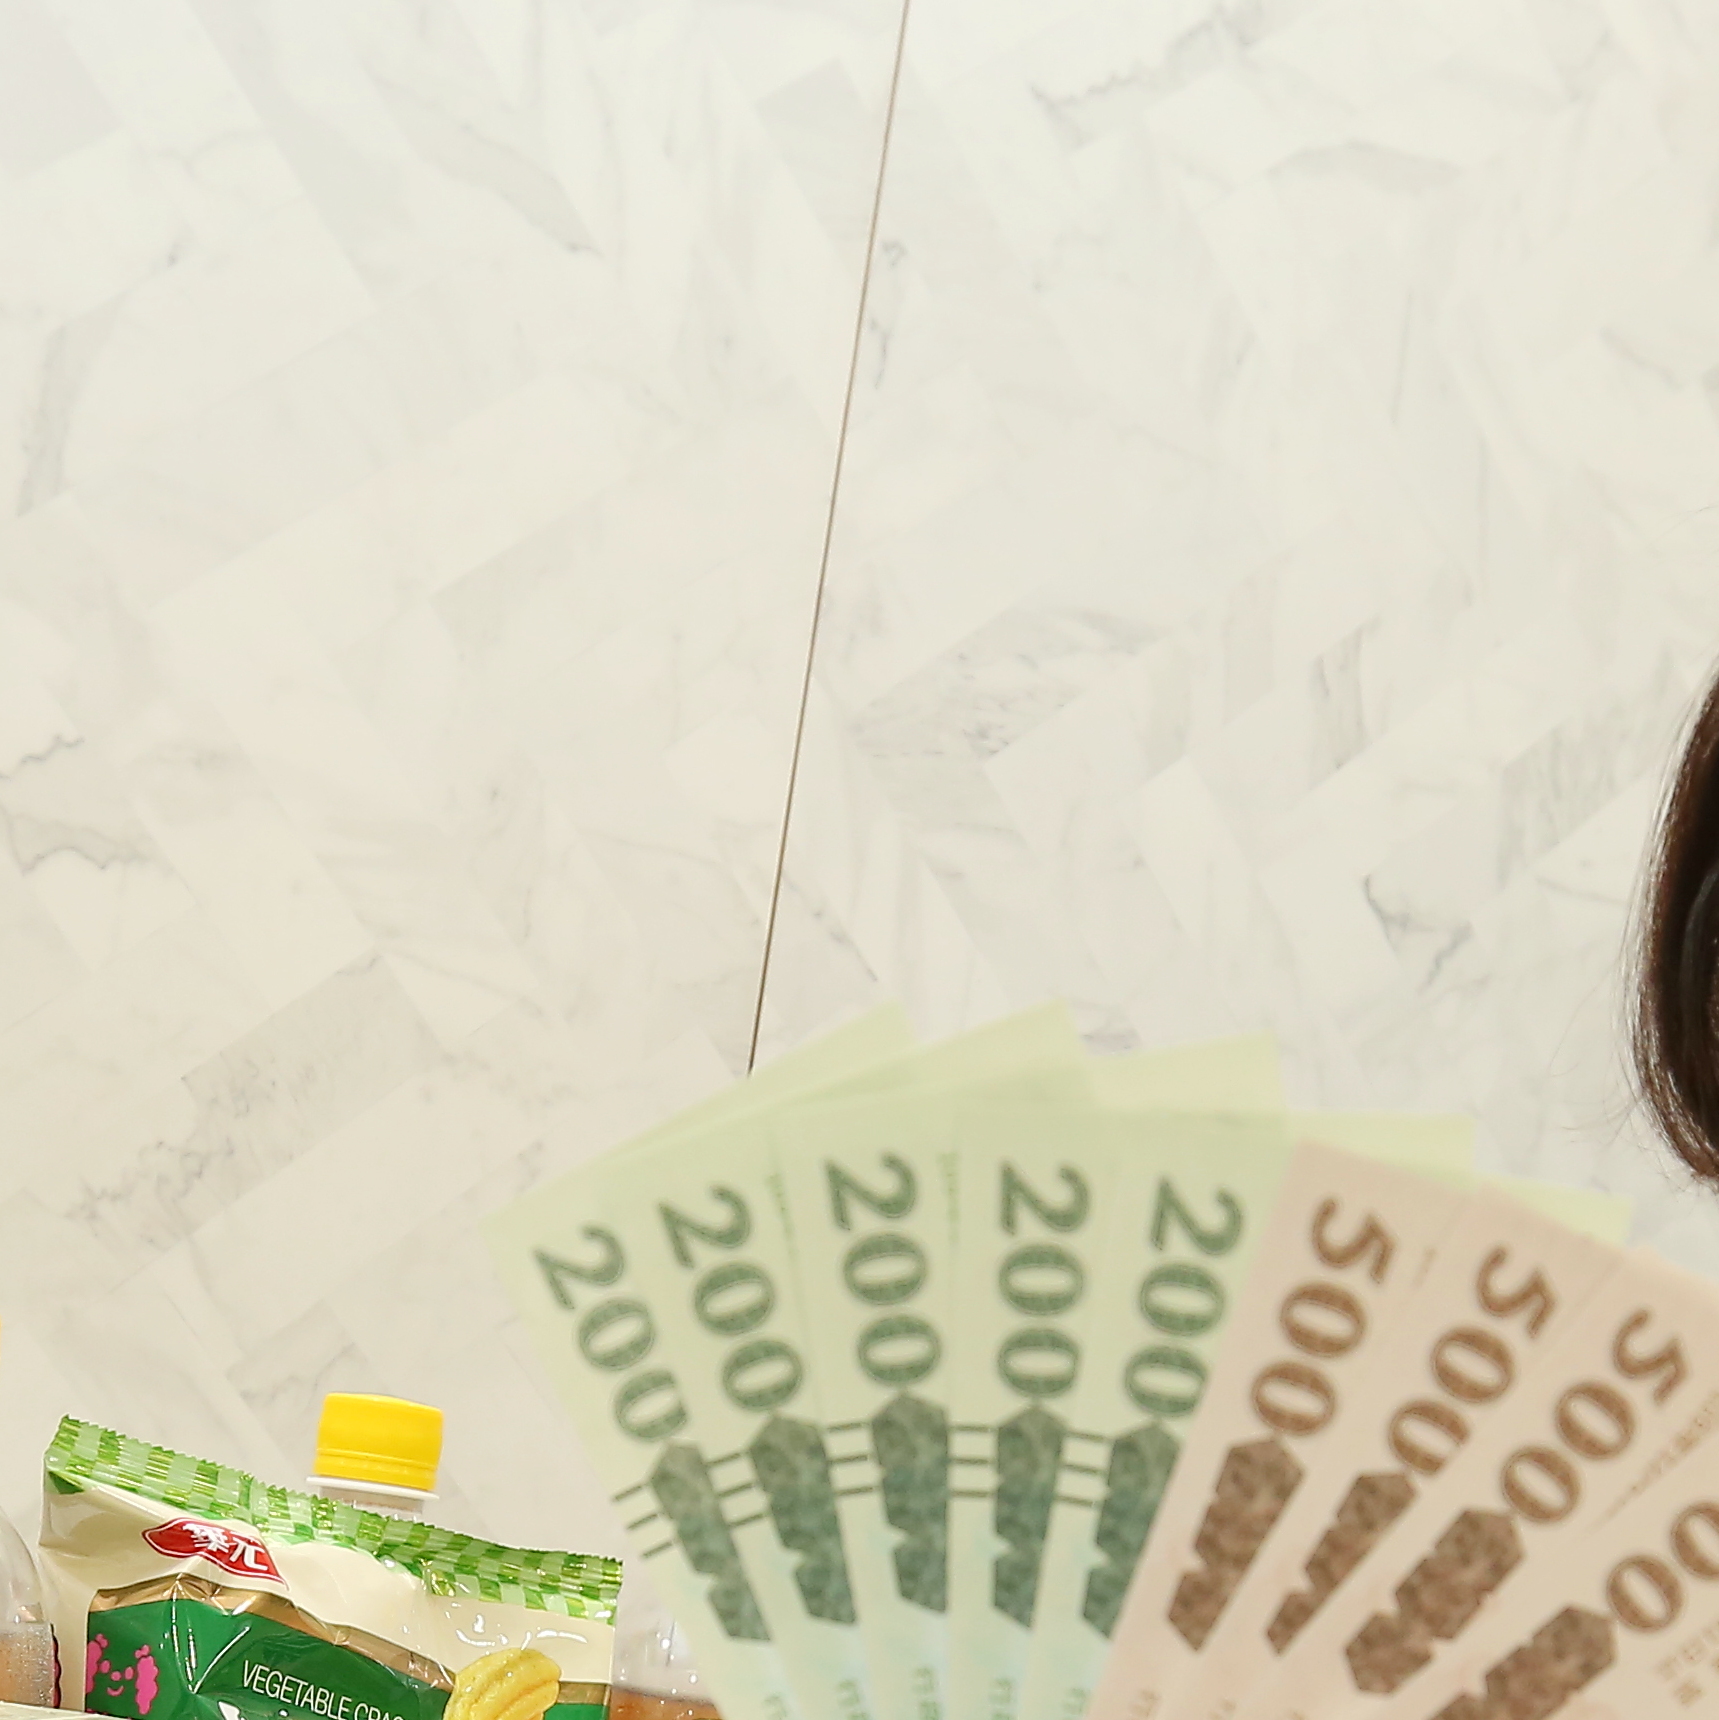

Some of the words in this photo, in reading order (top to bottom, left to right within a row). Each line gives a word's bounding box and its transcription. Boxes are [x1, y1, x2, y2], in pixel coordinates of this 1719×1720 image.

[534, 1223, 688, 1444] 200
[657, 1186, 805, 1413] 200
[824, 1152, 942, 1386] 200
[994, 1162, 1090, 1397] 200
[1124, 1177, 1244, 1419] 200
[1249, 1198, 1395, 1442] 500
[1386, 1246, 1556, 1479] 500
[1498, 1307, 1691, 1528] 500
[181, 1524, 268, 1571] 華元
